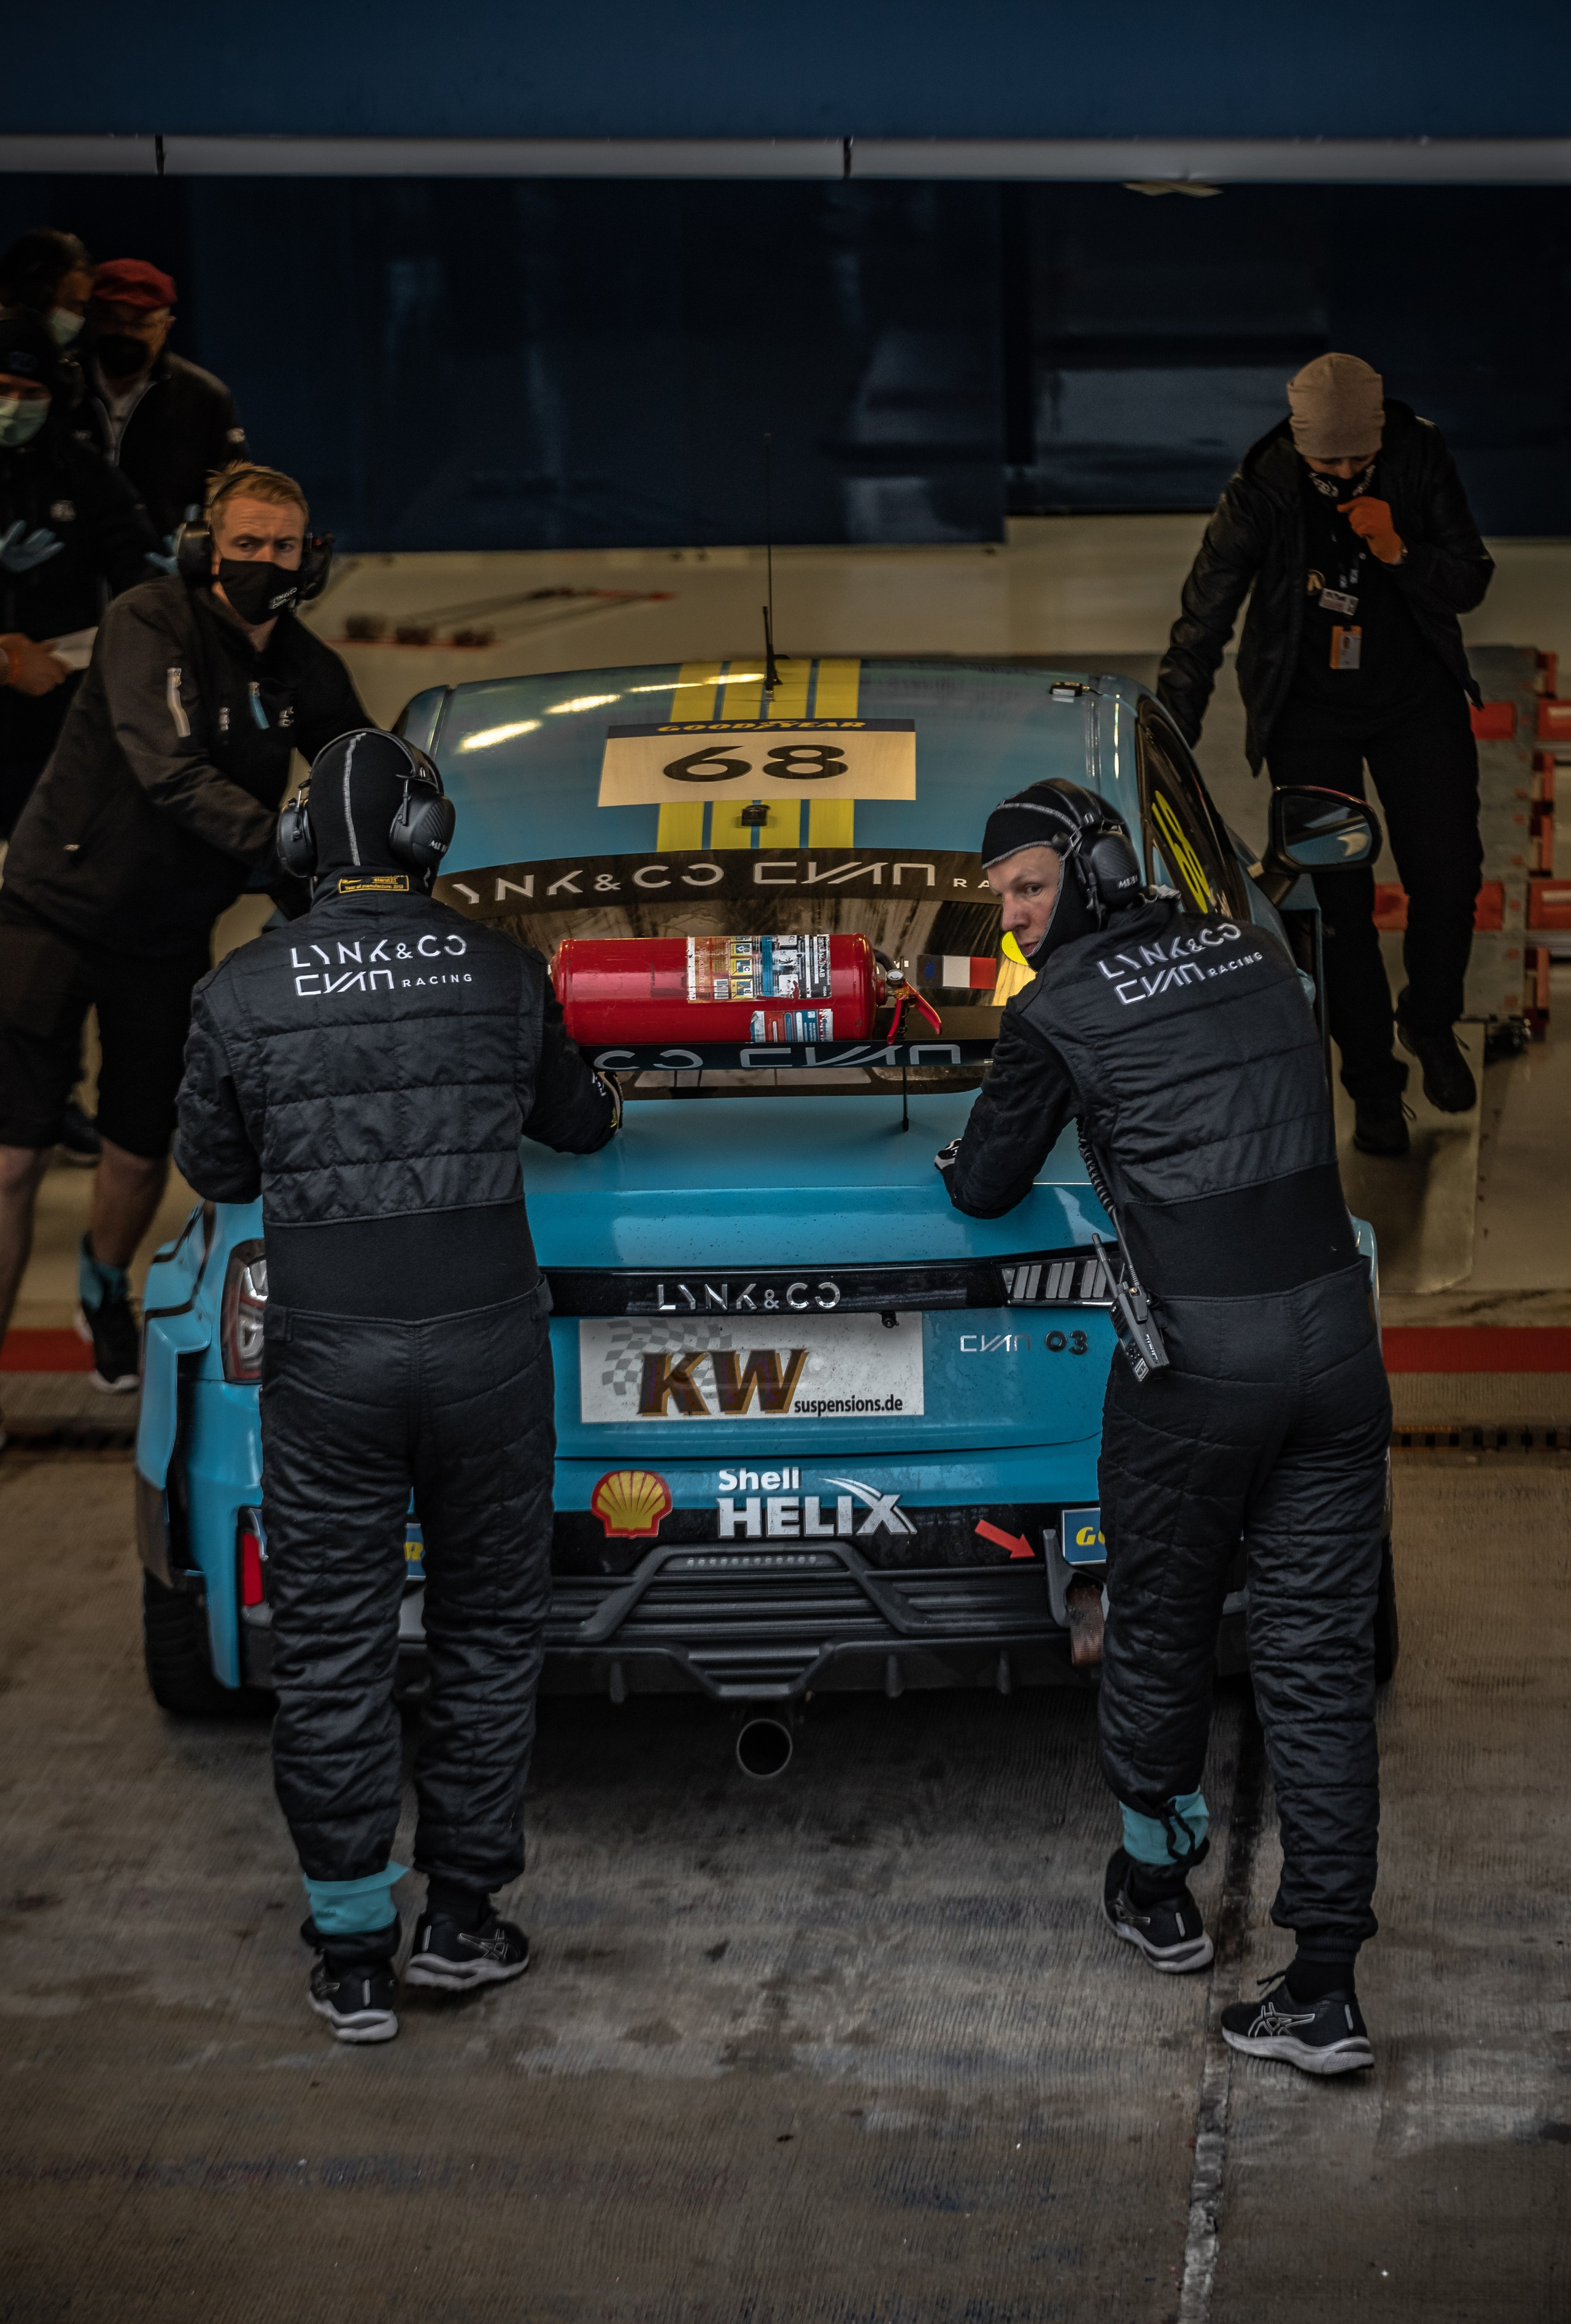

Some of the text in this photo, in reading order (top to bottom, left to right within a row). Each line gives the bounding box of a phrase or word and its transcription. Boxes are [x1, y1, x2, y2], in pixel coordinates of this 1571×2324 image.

[657, 720, 867, 733] GOODYEAR
[663, 744, 849, 782] 68
[452, 863, 725, 904] YNK&CO
[290, 934, 467, 968] LYNK&CO
[1097, 923, 1242, 980] LYNK&CO
[1207, 951, 1264, 977] RACING
[402, 973, 473, 988] RACING
[657, 1282, 841, 1310] LYNK&CO
[1045, 1330, 1089, 1355] 03
[637, 1349, 903, 1417] KW suspensions.de
[719, 1466, 800, 1491] Shell
[716, 1477, 918, 1538] HELIX
